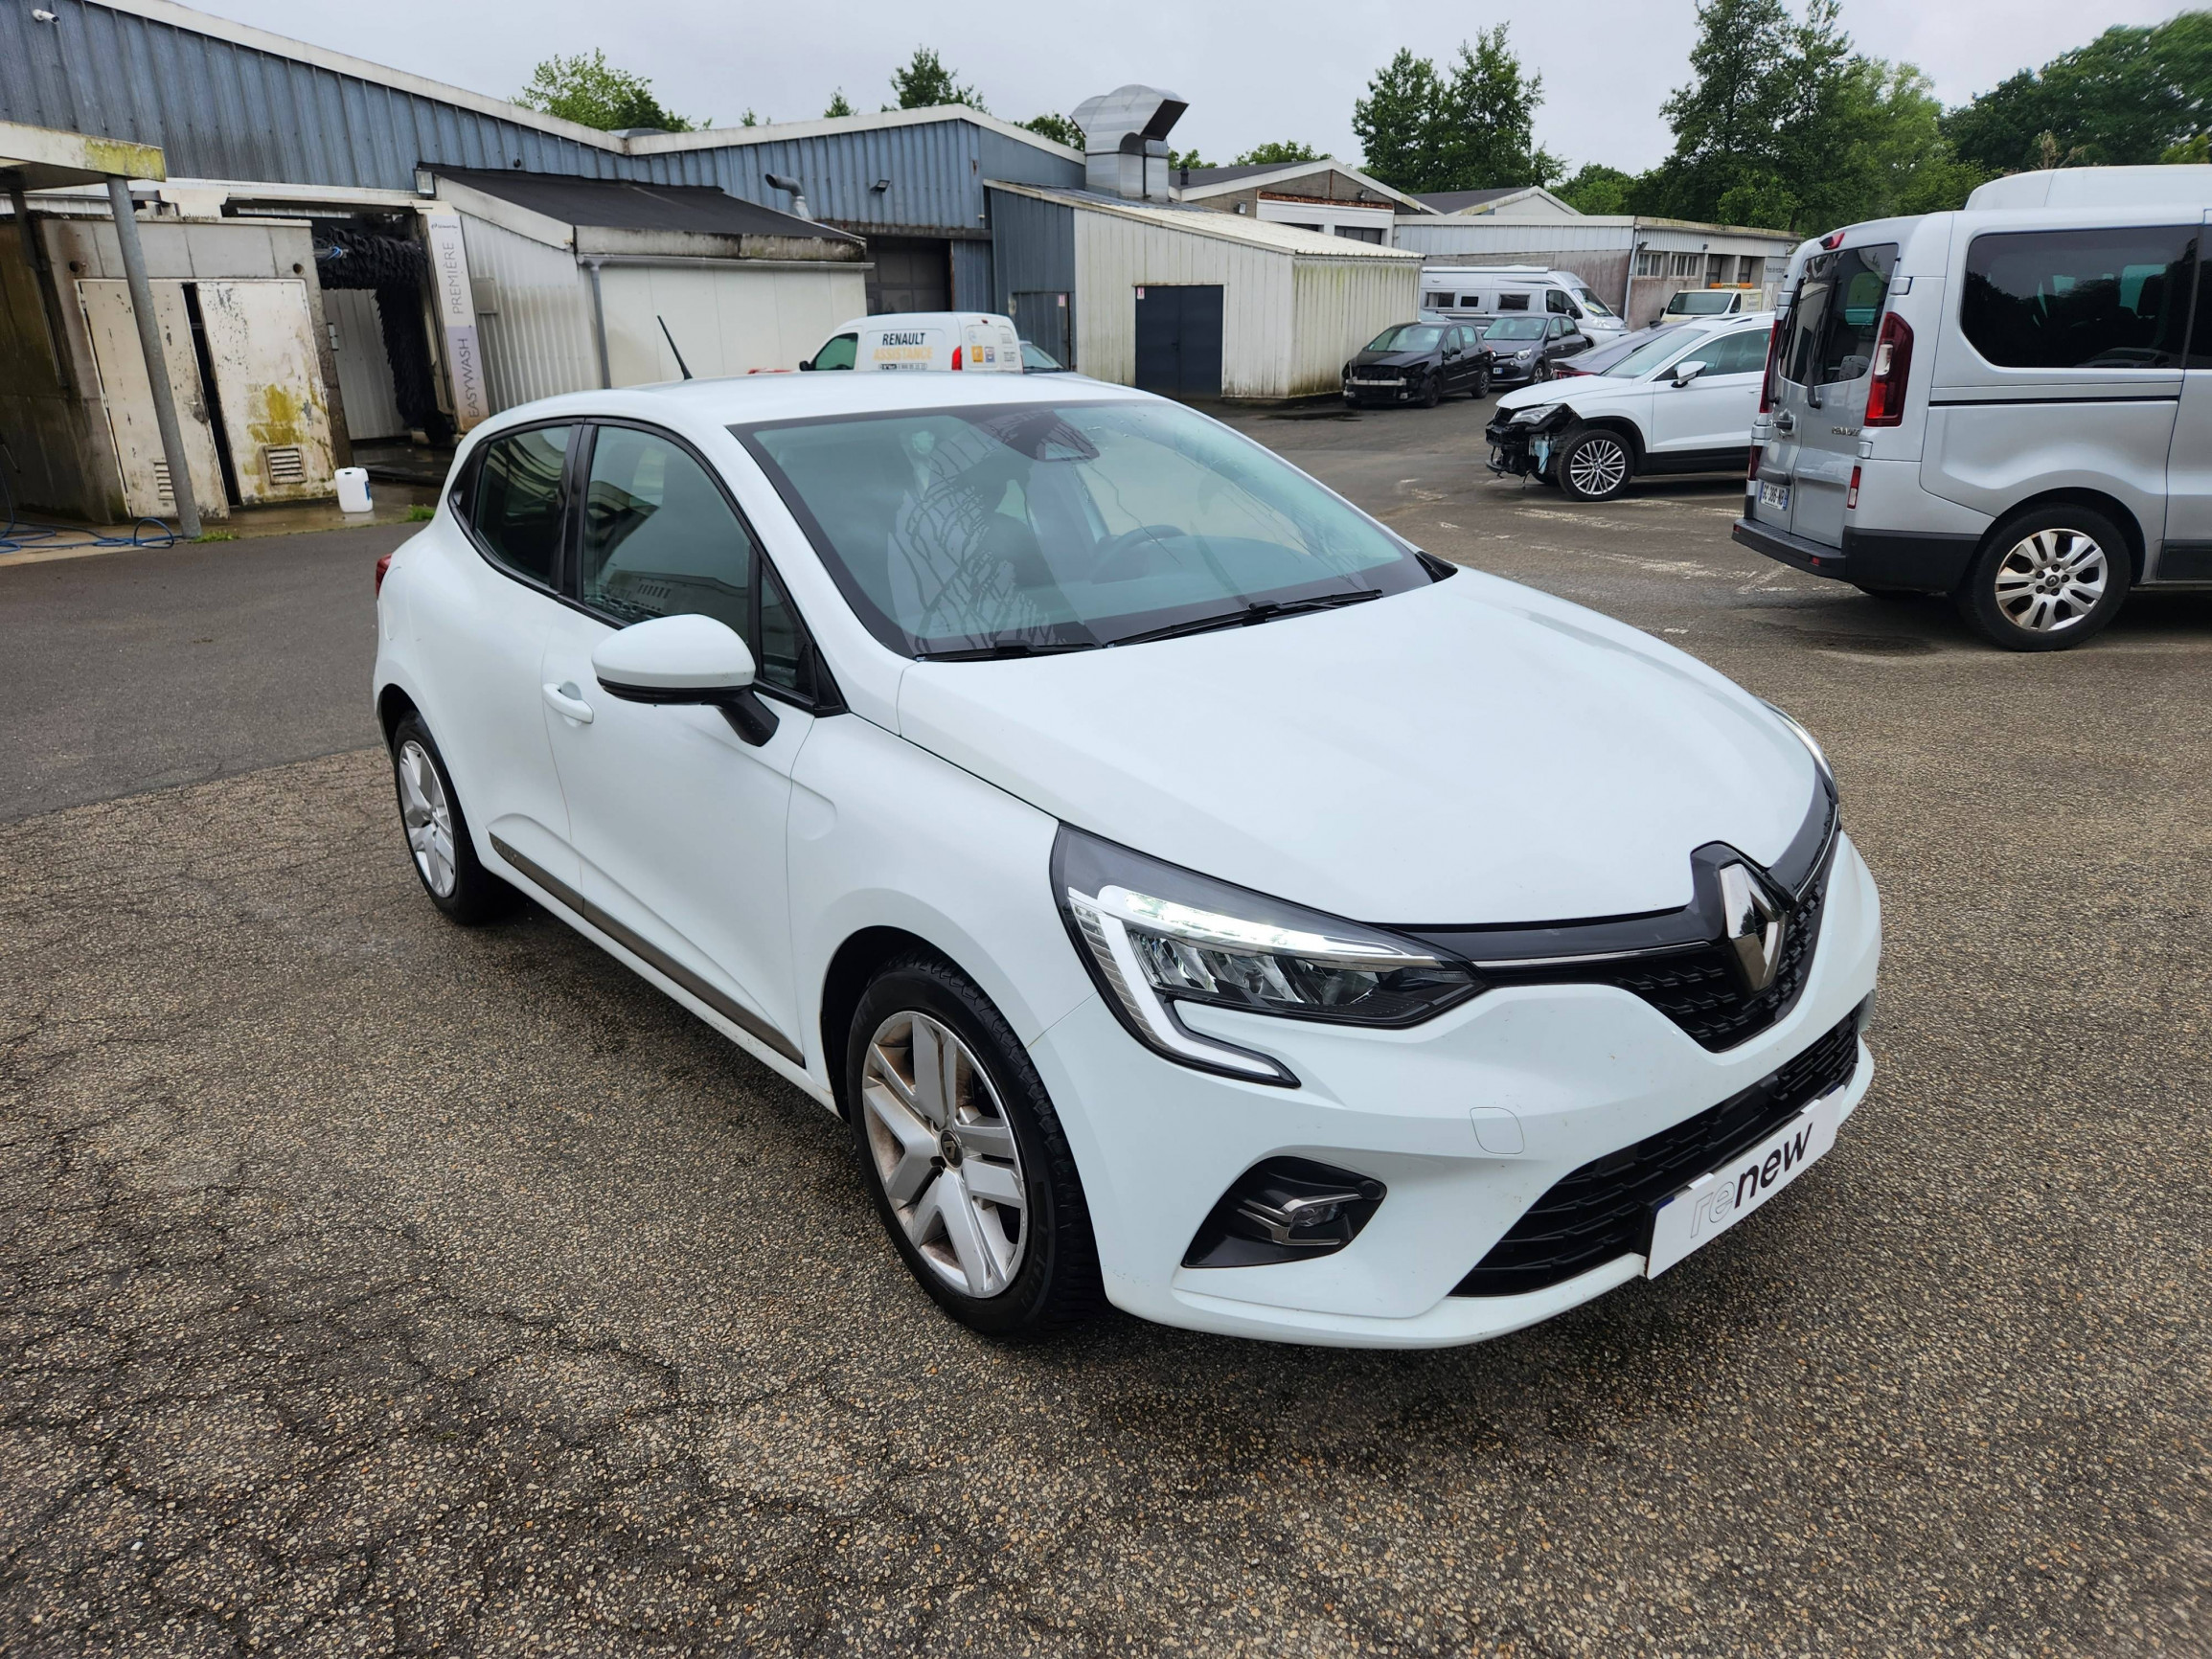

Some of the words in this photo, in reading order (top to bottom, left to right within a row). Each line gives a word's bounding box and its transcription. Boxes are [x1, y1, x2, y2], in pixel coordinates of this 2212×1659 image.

[443, 242, 464, 314] PREMIÈRE
[873, 346, 933, 361] ASSISTANCE
[882, 332, 926, 346] RENAULT
[458, 338, 479, 418] EASYWASH
[1690, 1122, 1813, 1239] renew
